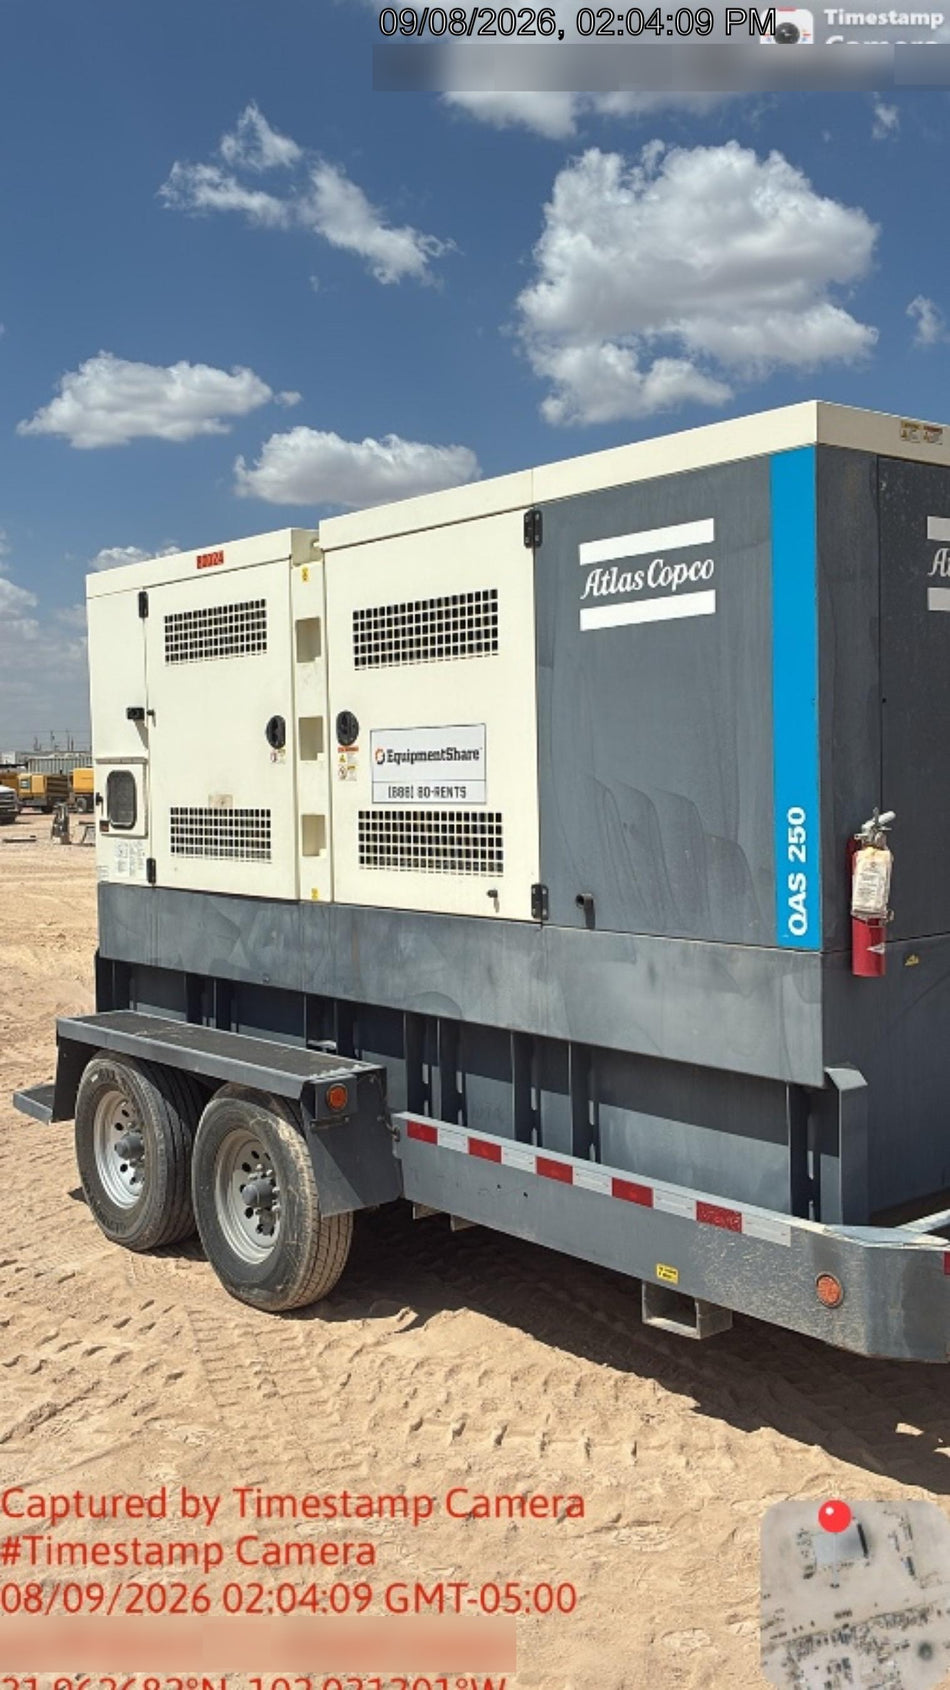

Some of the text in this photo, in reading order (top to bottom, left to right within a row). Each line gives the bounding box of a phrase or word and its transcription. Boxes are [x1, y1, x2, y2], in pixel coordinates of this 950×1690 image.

[580, 558, 714, 600] Atlas Copco
[386, 747, 480, 765] EquipmentShare
[786, 806, 809, 936] QAS 250
